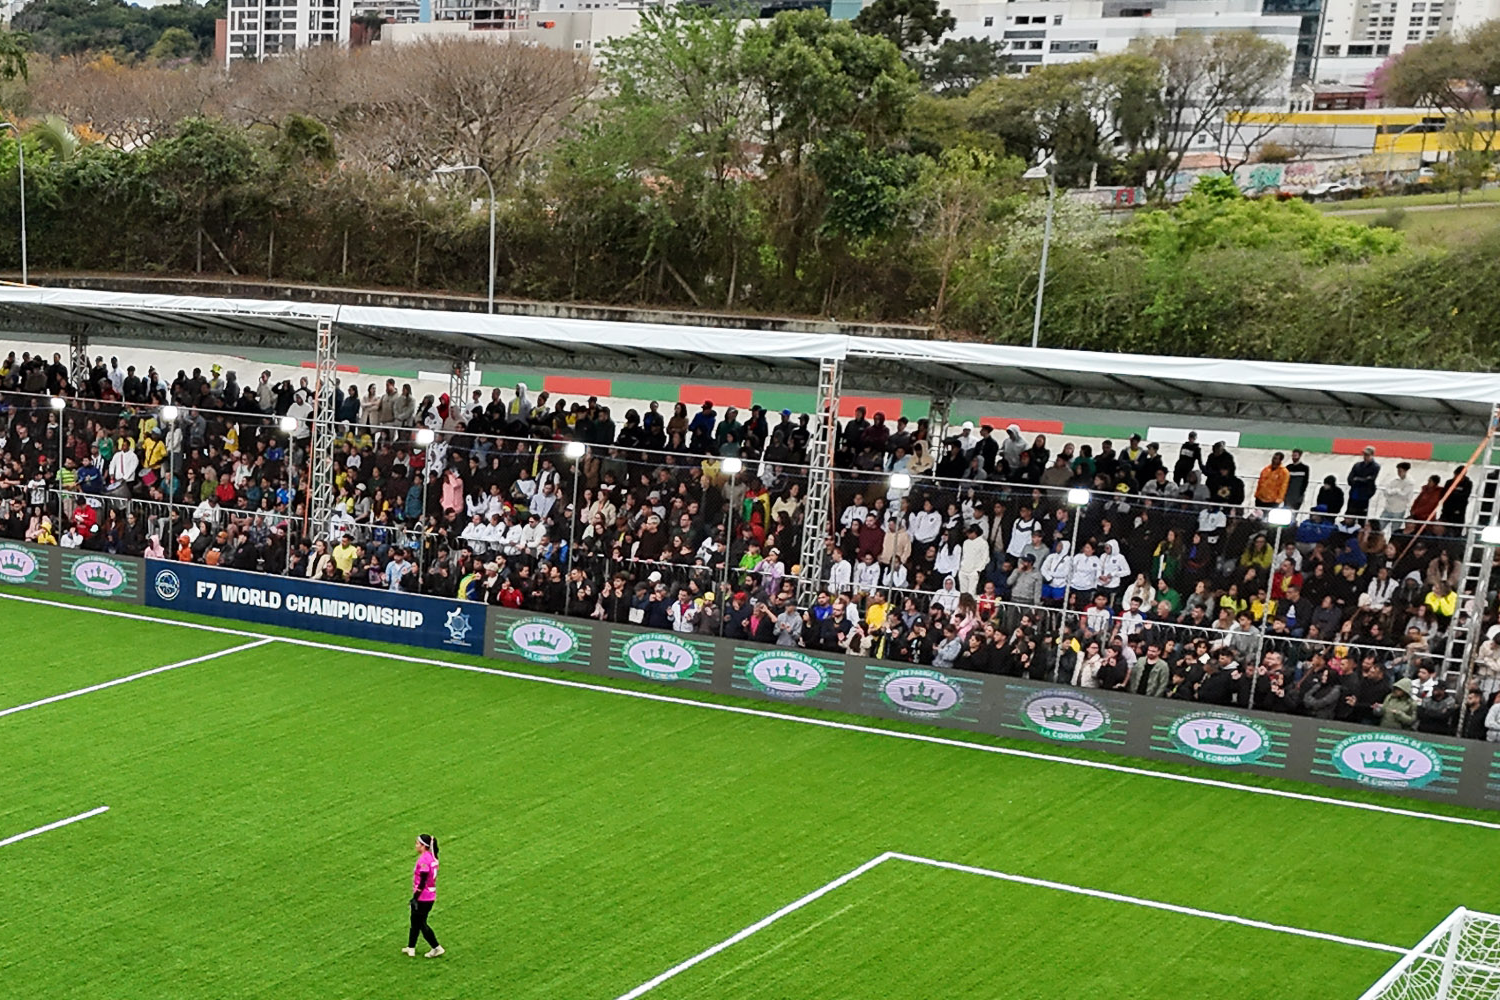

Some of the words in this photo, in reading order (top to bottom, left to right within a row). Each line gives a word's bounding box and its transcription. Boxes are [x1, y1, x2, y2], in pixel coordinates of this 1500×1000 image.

[196, 581, 217, 599] F7
[221, 585, 282, 609] WORLD
[285, 595, 424, 629] CHAMPIONSHIP
[1192, 749, 1204, 758] LA
[1205, 754, 1243, 763] CORONA
